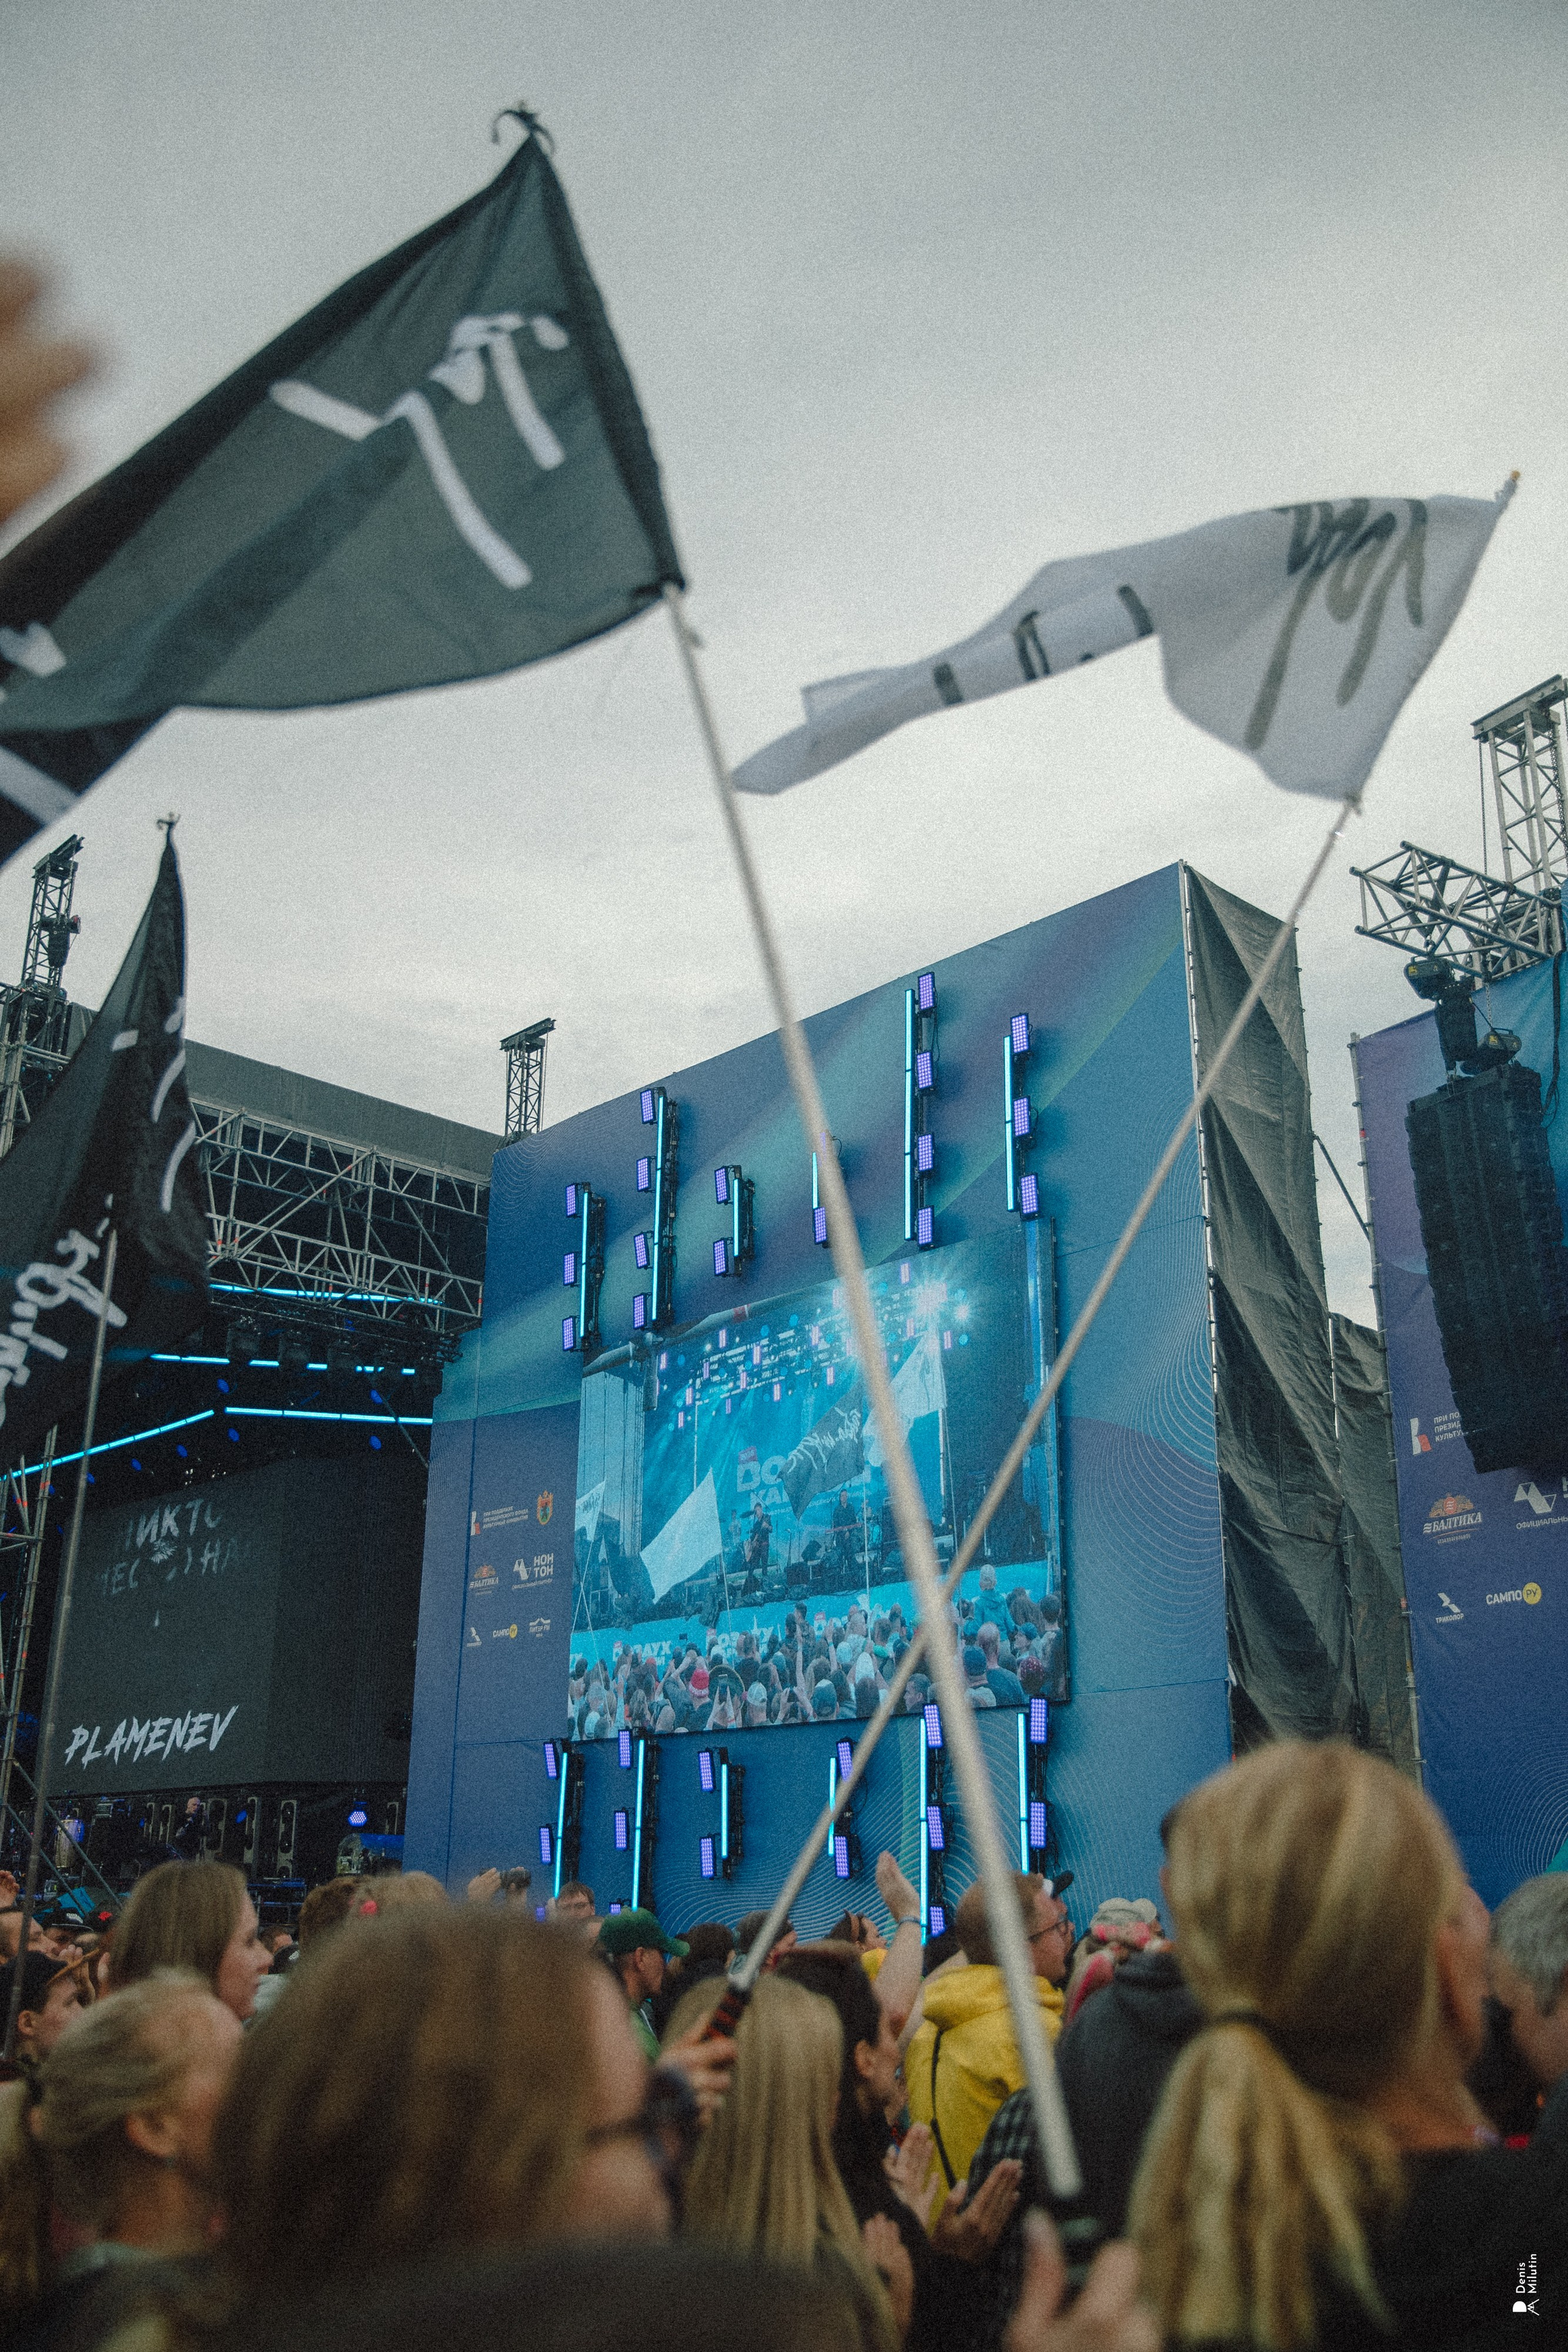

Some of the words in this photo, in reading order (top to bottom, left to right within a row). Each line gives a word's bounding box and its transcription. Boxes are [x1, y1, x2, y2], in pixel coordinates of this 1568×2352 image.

[1434, 1414, 1447, 1424] ПРИ
[1449, 1411, 1460, 1420] ПО
[1434, 1420, 1461, 1433] ПРЕЗИД
[1435, 1430, 1461, 1442] КУЛЬТУ
[1433, 1512, 1482, 1532] БАЛТИКА
[533, 1553, 554, 1567] НОН
[533, 1564, 553, 1578] ТОН
[1435, 1613, 1464, 1624] ТРИКОЛОР
[64, 1705, 239, 1771] PLAMENEV
